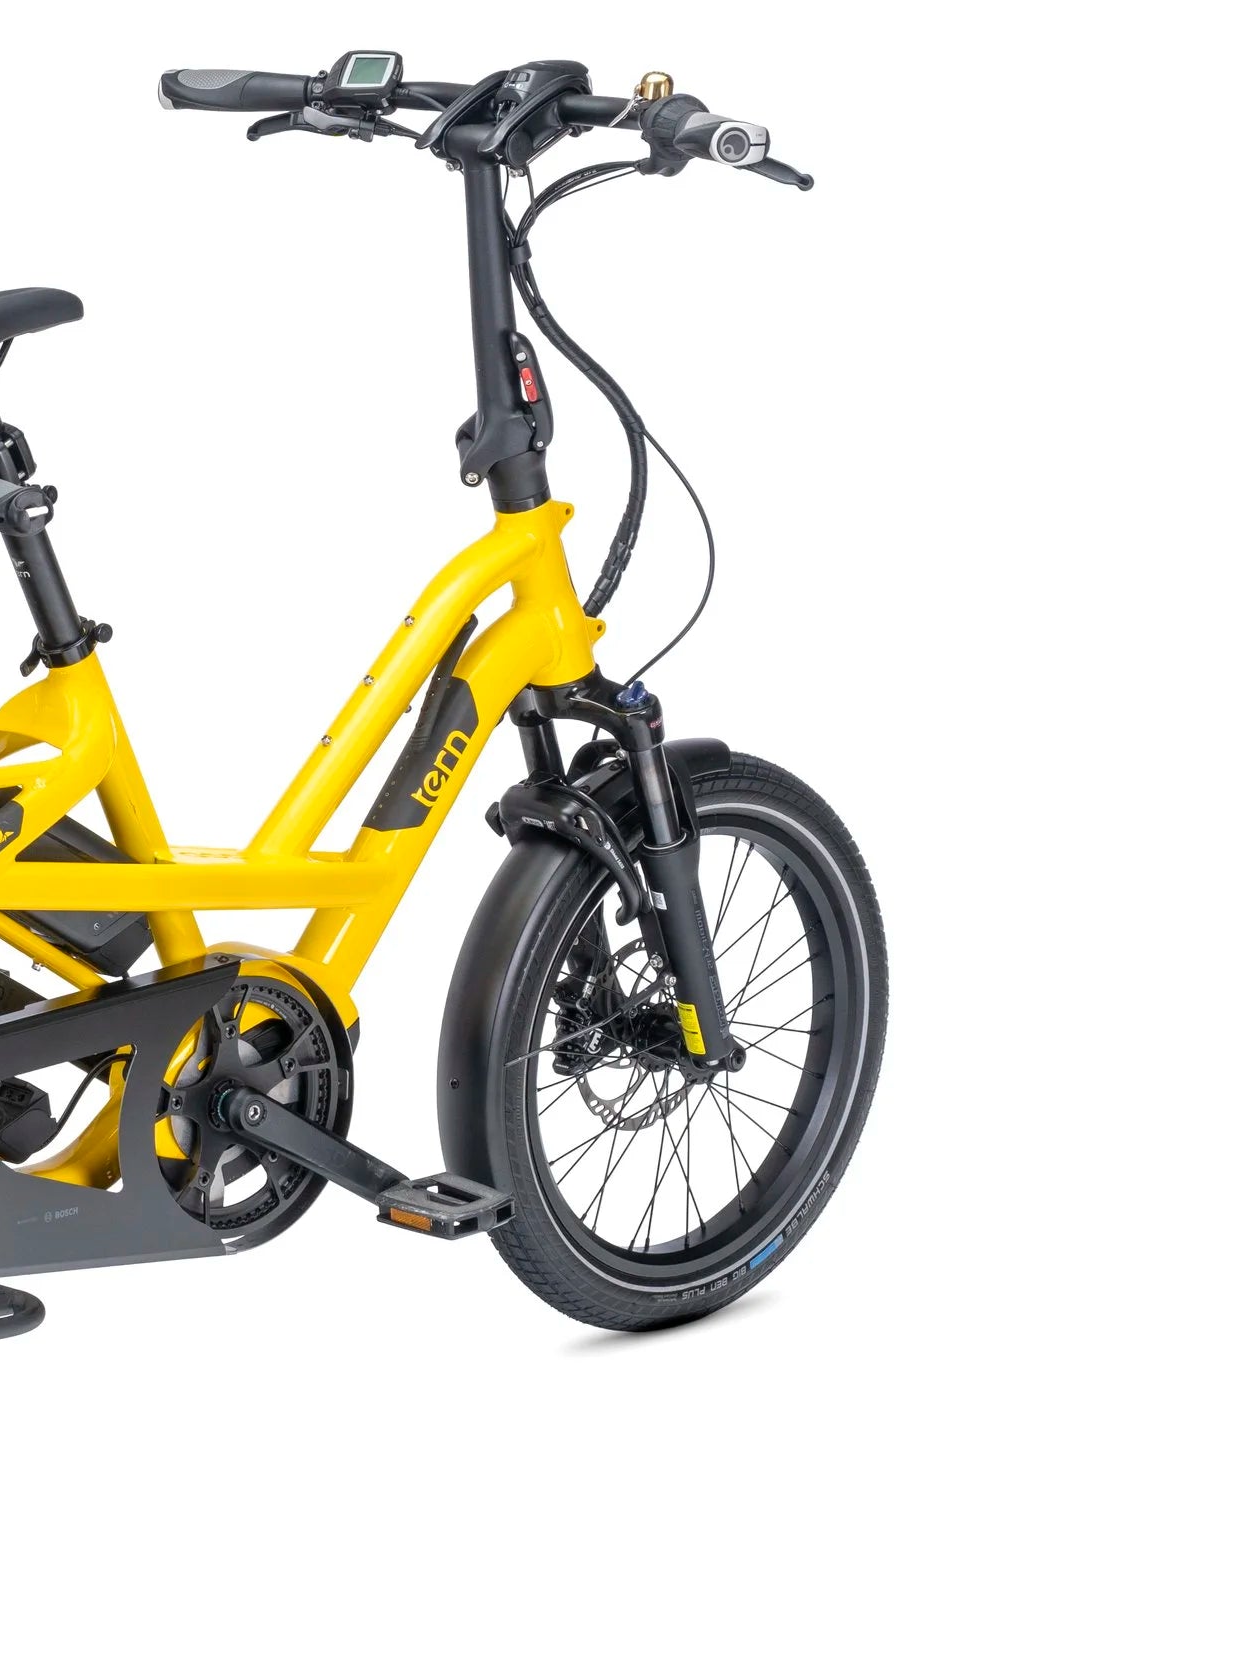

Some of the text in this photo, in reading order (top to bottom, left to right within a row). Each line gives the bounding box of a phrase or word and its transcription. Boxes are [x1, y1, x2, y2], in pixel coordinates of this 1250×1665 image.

[410, 730, 471, 807] tern
[785, 1170, 831, 1238] SCHWALBE
[54, 1206, 79, 1219] BOSCH
[732, 1265, 747, 1281] BIG
[681, 1286, 706, 1299] PLUS
